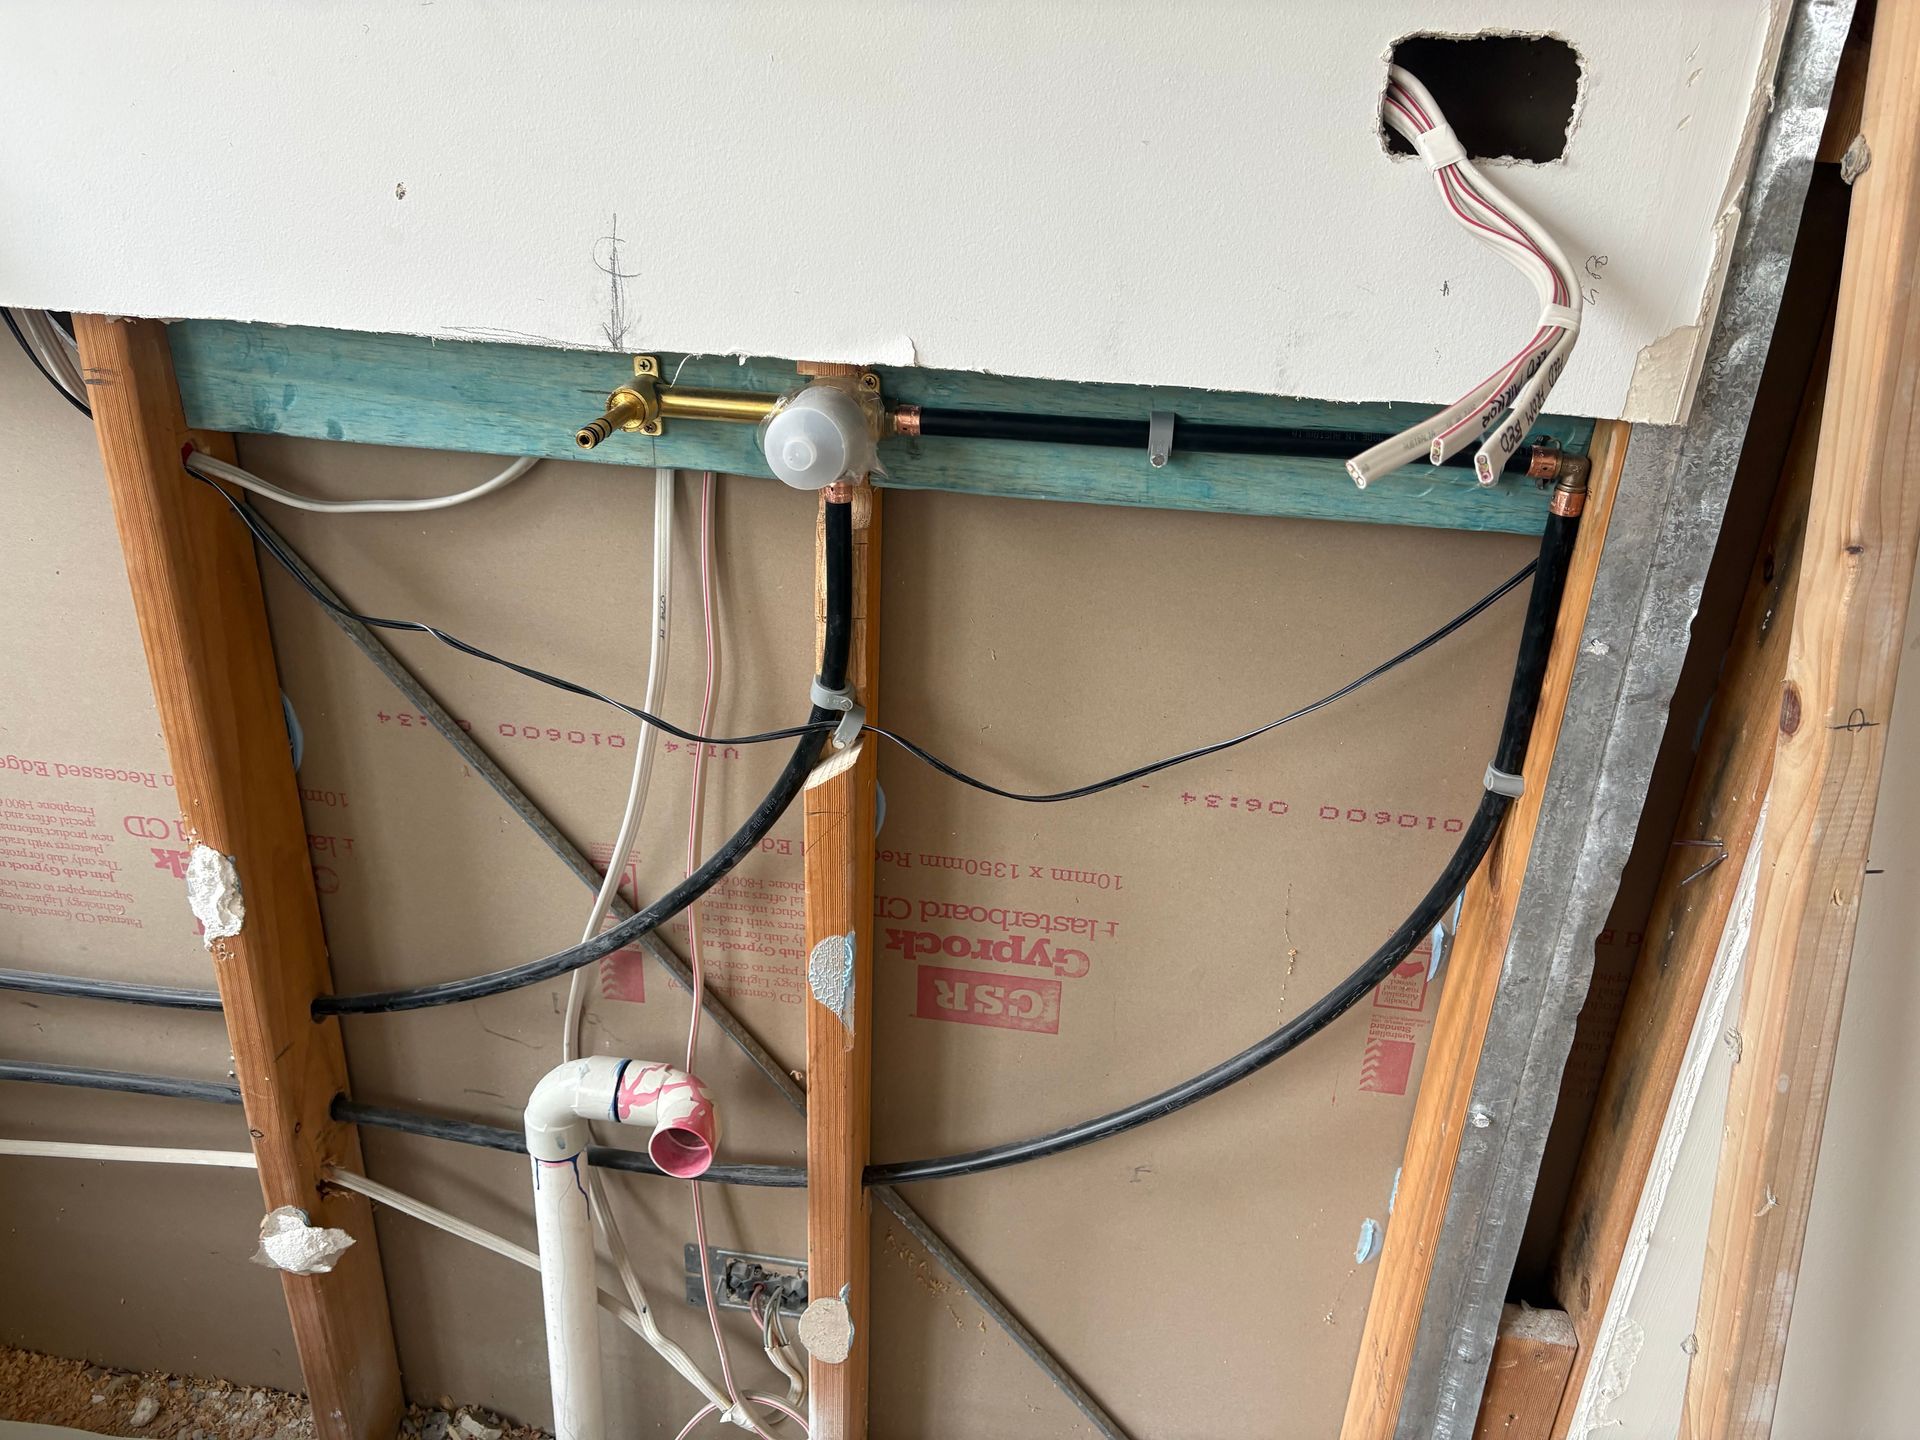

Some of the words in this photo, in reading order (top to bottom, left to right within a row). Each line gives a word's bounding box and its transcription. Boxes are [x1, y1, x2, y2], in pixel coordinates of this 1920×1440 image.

[1500, 418, 1523, 453] BED
[377, 710, 470, 734] 0:34
[499, 722, 625, 748] 010600
[54, 762, 157, 788] Recessed
[302, 789, 348, 808] 10m
[1181, 792, 1287, 816] 06:34
[4, 810, 24, 820] and
[38, 802, 94, 817] Freephone
[26, 814, 57, 826] offers
[60, 816, 95, 828] special
[1320, 806, 1462, 833] 010600
[0, 824, 44, 837] informa
[46, 828, 88, 840] product
[123, 816, 168, 840] CD
[27, 838, 52, 849] with
[90, 834, 113, 842] new
[54, 842, 103, 856] plasterers
[28, 850, 44, 862] for
[46, 854, 68, 864] club
[71, 854, 95, 866] only
[8, 861, 60, 876] Gyprock
[98, 860, 121, 871] The
[920, 853, 1019, 880] 1350mm
[62, 868, 87, 879] club
[90, 870, 114, 882] Join
[1028, 866, 1042, 879] x
[18, 880, 40, 890] core
[730, 876, 764, 888] 1-800
[1050, 868, 1122, 890] 10mm
[42, 884, 53, 892] to
[56, 884, 88, 895] paper
[25, 892, 62, 907] Lighter
[726, 890, 748, 900] and
[750, 892, 786, 904] offers
[75, 912, 95, 923] CD
[97, 914, 143, 928] Patented
[714, 914, 743, 926] trade
[746, 918, 774, 929] with
[672, 923, 741, 938] professnal
[745, 931, 761, 942] for
[763, 934, 789, 944] club
[716, 941, 775, 956] Gyprock
[778, 948, 805, 958] club
[884, 928, 1089, 978] Gyprock
[724, 960, 748, 970] core
[750, 964, 763, 972] to
[767, 964, 798, 976] paper
[728, 974, 768, 987] Lighter
[780, 994, 801, 1004] CD
[934, 980, 1043, 1020] CSR
[1369, 1028, 1414, 1040] Australian
[1370, 1022, 1411, 1034] Standard
